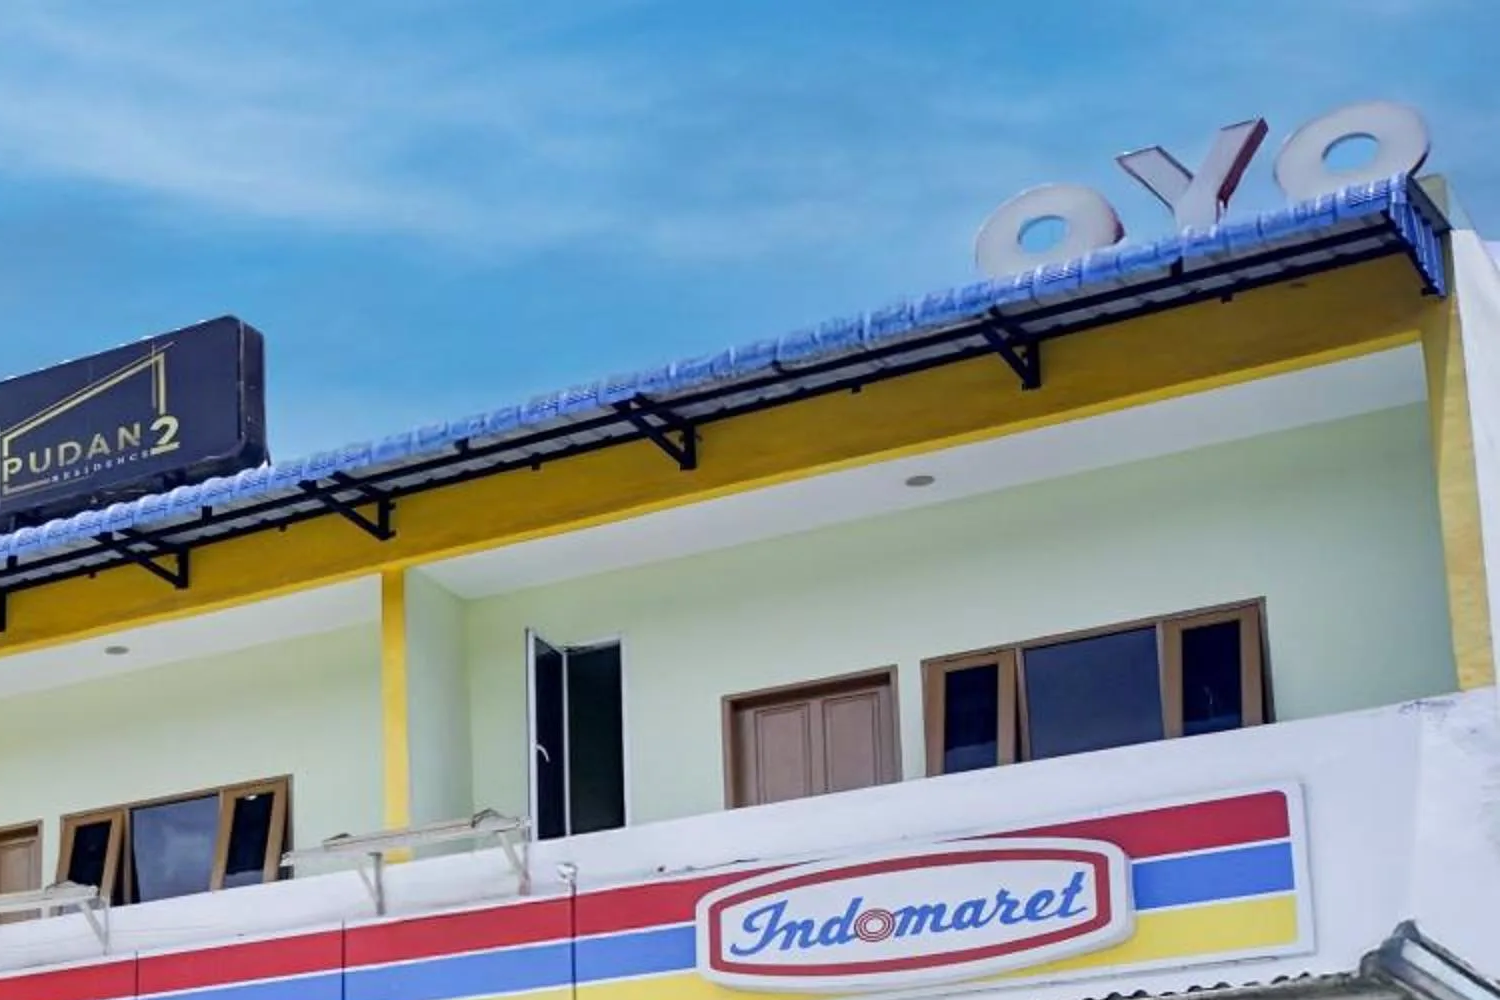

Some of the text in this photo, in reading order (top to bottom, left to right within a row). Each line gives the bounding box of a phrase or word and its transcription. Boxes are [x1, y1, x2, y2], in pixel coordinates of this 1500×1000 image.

[975, 101, 1432, 280] OYO
[3, 415, 181, 482] PUDAN 2
[729, 870, 1088, 958] Indomaret
